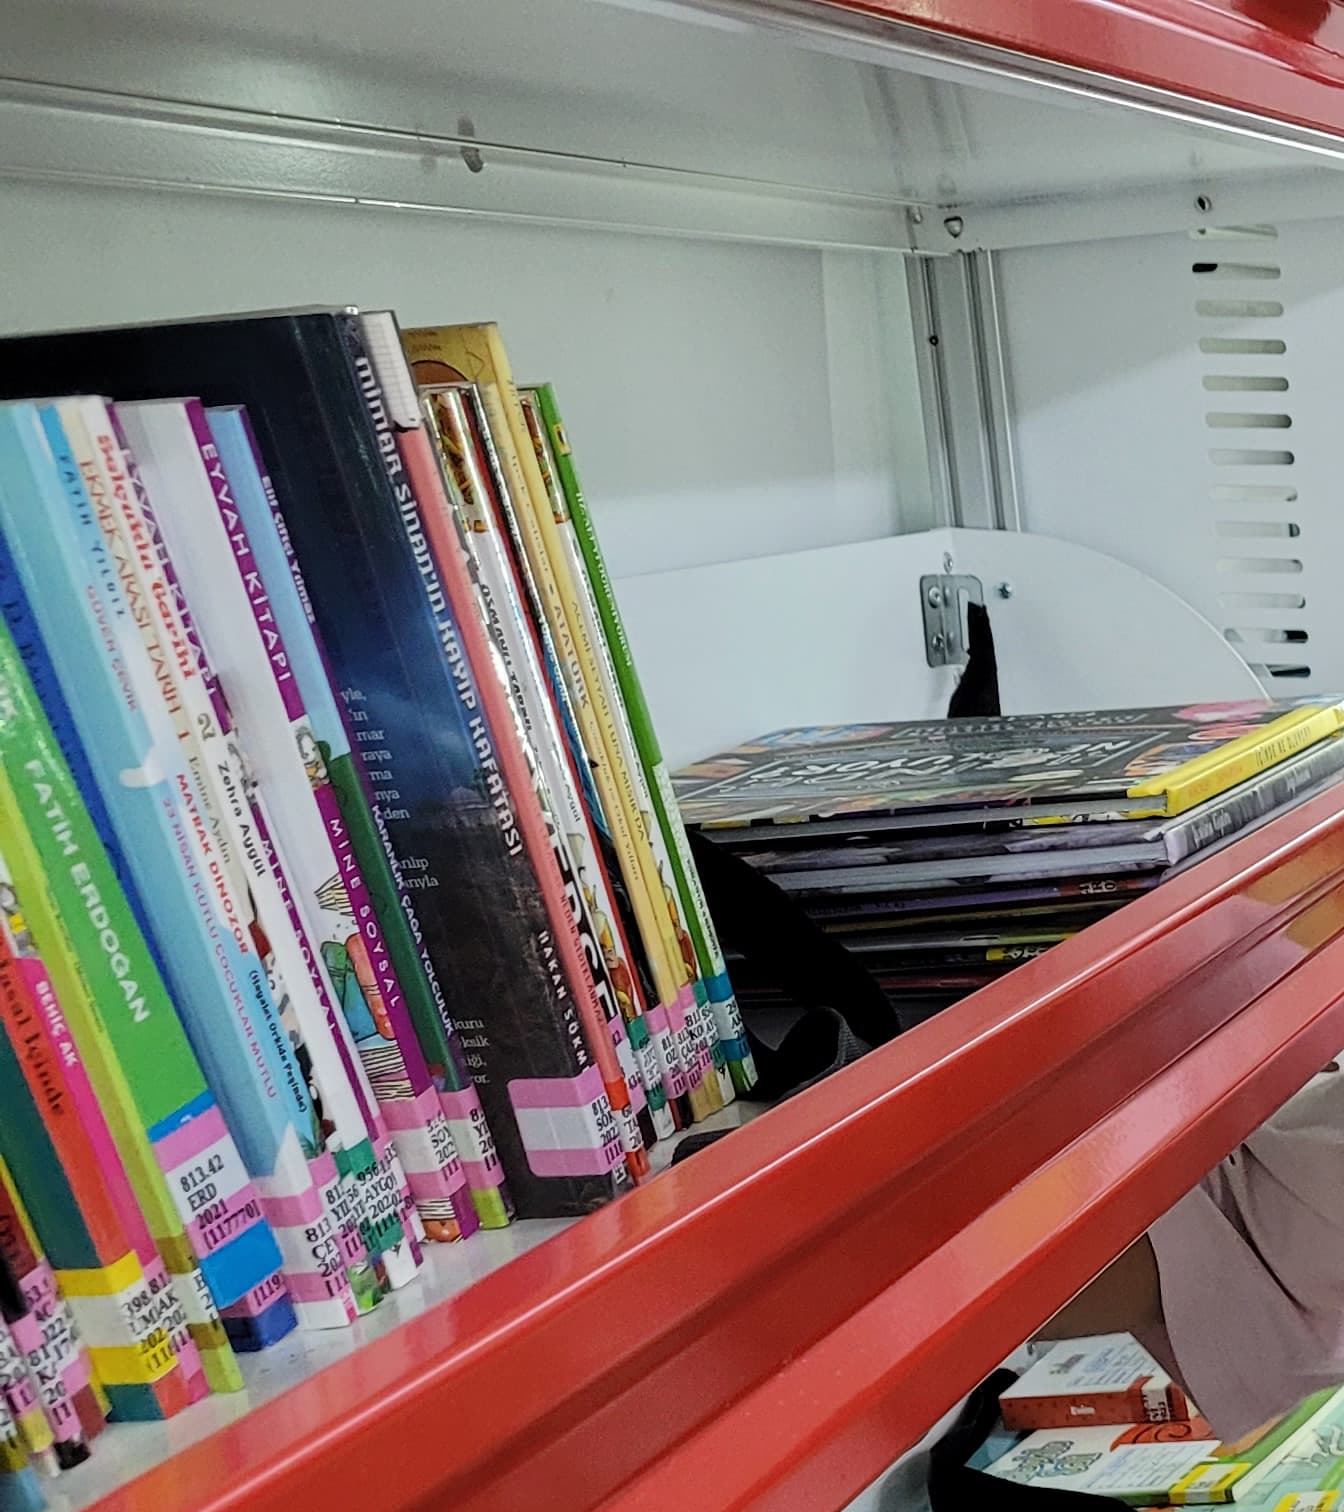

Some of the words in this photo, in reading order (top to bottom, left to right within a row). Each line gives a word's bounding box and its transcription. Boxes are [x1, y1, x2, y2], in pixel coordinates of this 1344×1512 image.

[198, 442, 251, 557] EYVAH
[79, 457, 125, 551] EKMEK
[112, 551, 153, 630] ARASI
[547, 603, 595, 708] ATATÜRK
[172, 771, 216, 856] MATRAK
[215, 760, 245, 817] Zehra
[68, 860, 153, 1024] ERDOĞAN
[353, 904, 405, 1008] SOYSAL
[370, 804, 406, 890] KARANLIK
[418, 947, 455, 1038] YOLCULUK
[531, 928, 571, 1000] HAKAN
[55, 1039, 80, 1069] AK
[180, 1155, 224, 1192] 813.42
[188, 1184, 216, 1212] ERD
[195, 1200, 228, 1229] 2021
